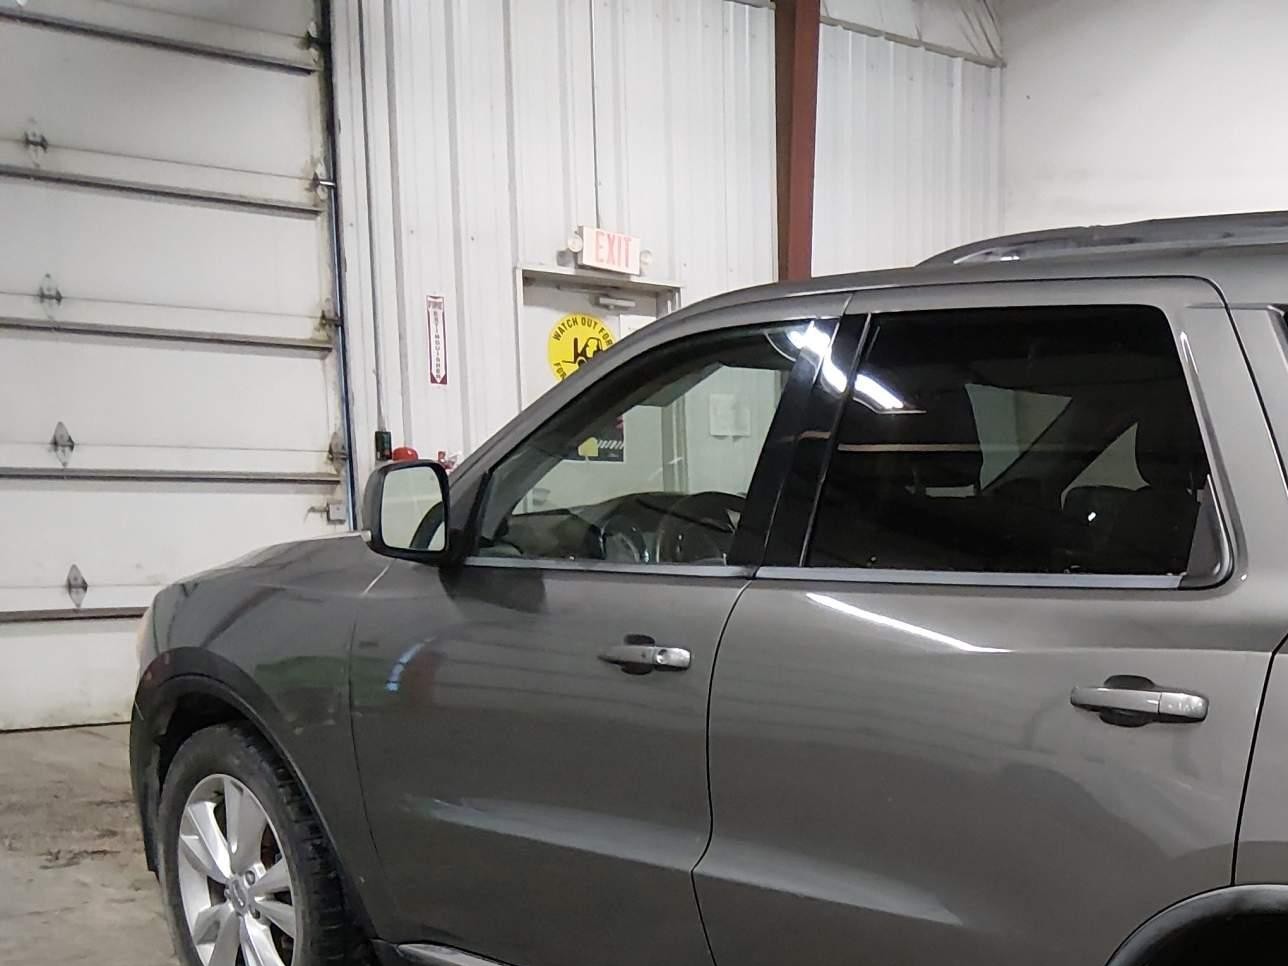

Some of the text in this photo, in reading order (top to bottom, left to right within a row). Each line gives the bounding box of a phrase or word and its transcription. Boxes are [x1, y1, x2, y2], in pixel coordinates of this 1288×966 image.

[595, 230, 632, 268] EXIT
[552, 316, 614, 347] WATCH OUT FOR
